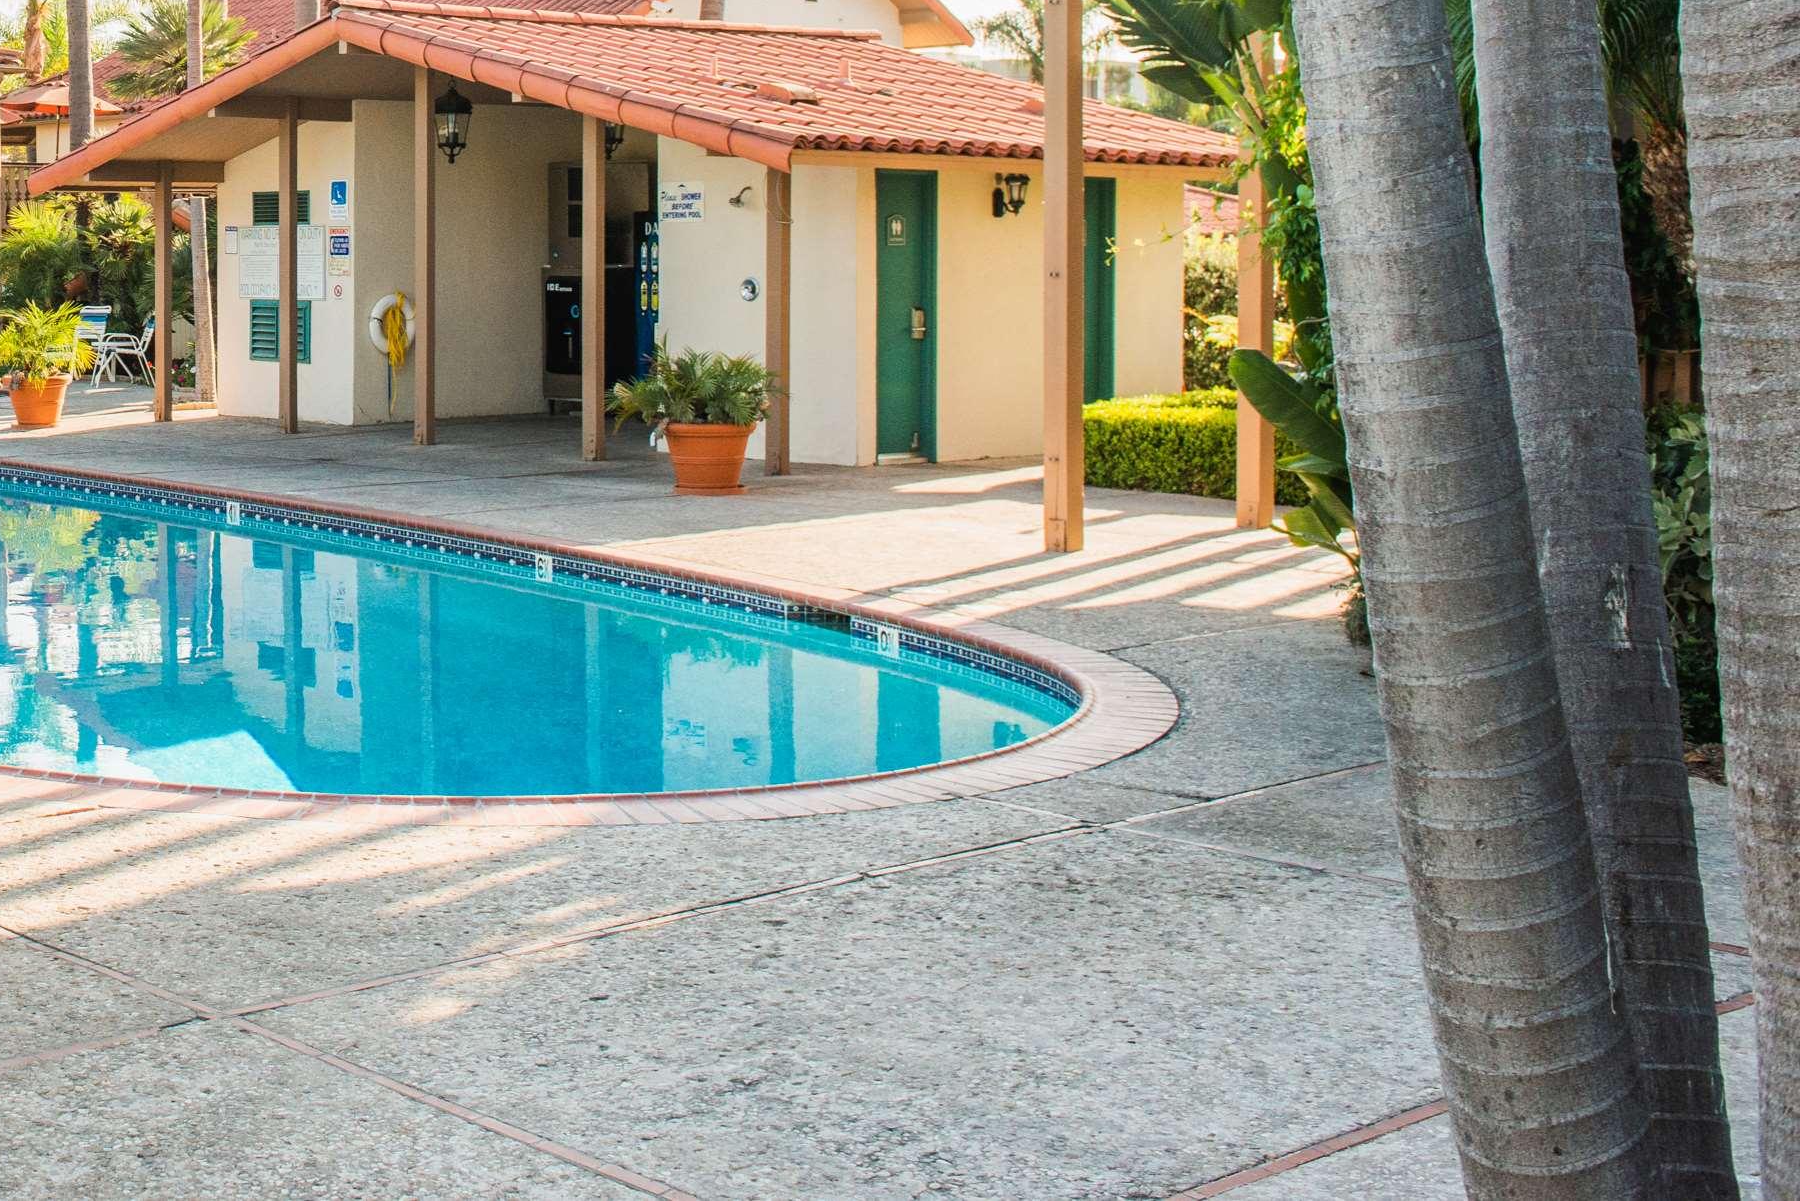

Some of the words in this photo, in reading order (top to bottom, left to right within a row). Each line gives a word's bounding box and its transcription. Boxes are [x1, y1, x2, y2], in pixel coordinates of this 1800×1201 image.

[681, 192, 701, 200] SHOWER
[671, 202, 694, 210] BEFORE
[662, 211, 687, 219] ENTERING
[688, 211, 702, 219] POOL
